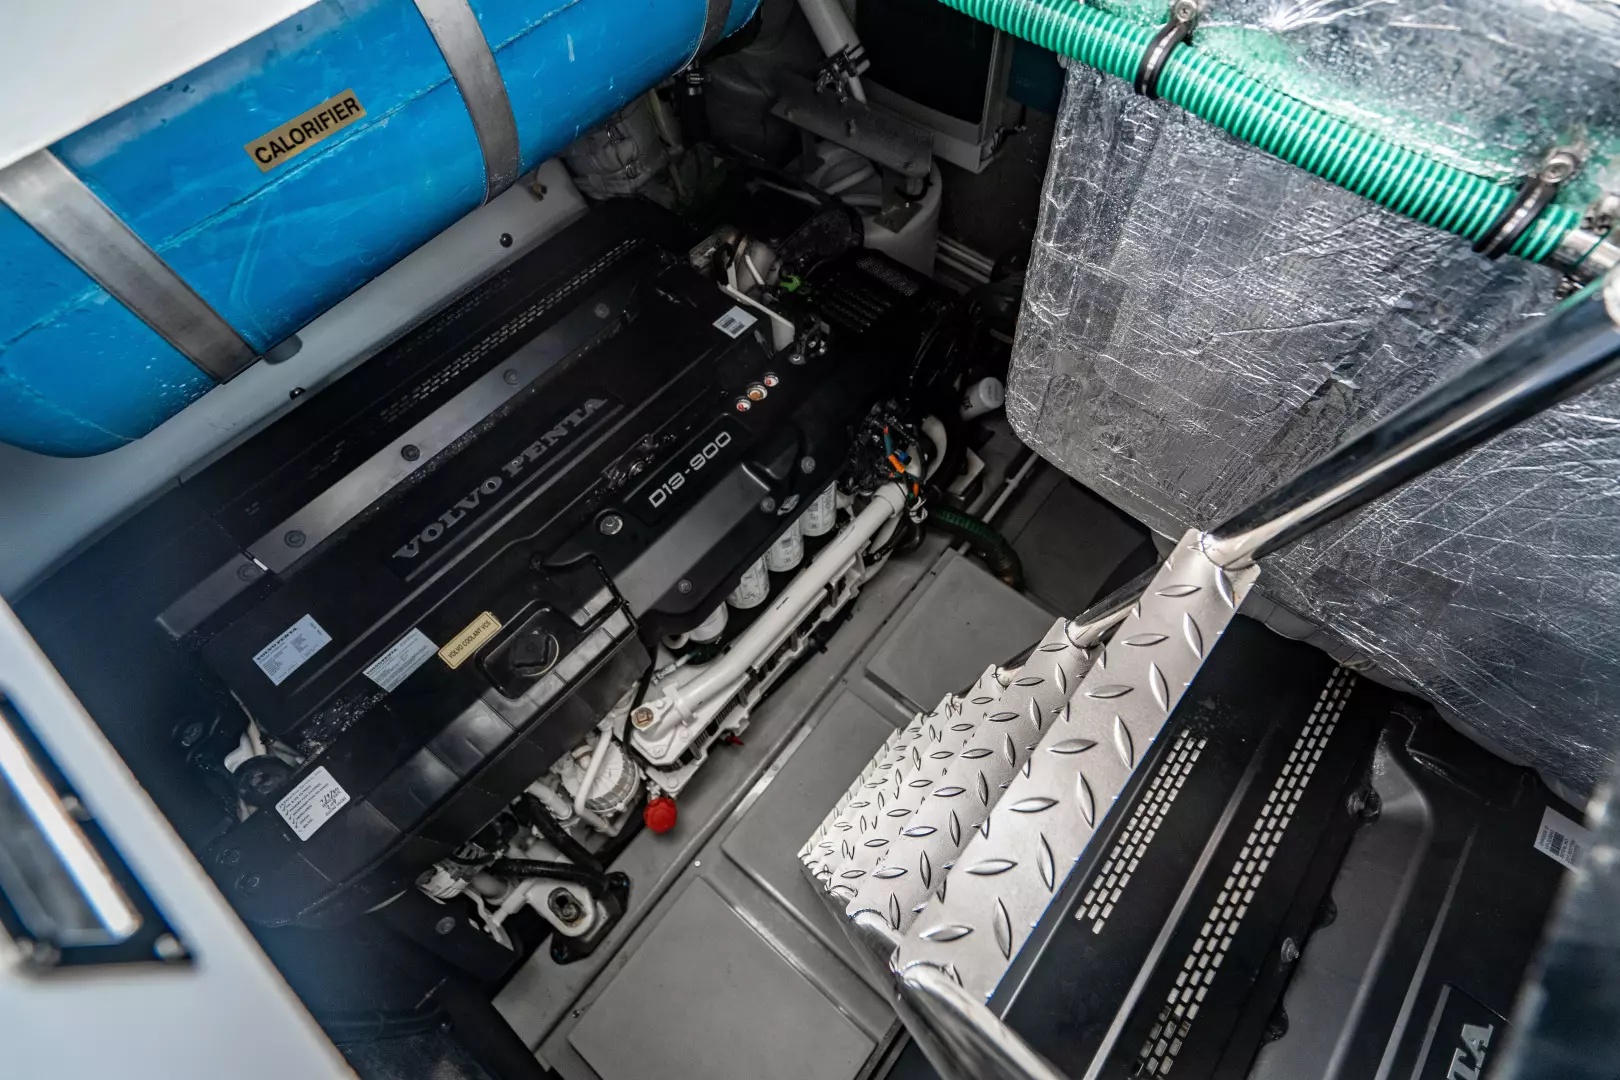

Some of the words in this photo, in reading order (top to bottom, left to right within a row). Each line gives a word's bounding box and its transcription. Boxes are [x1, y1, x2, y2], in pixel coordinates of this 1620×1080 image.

[255, 97, 361, 164] CALORIFIER
[391, 475, 503, 559] VOLVO
[502, 397, 609, 478] PENTA
[648, 431, 732, 508] D13-900
[447, 644, 464, 659] VOLVO
[462, 628, 483, 647] COOLANT
